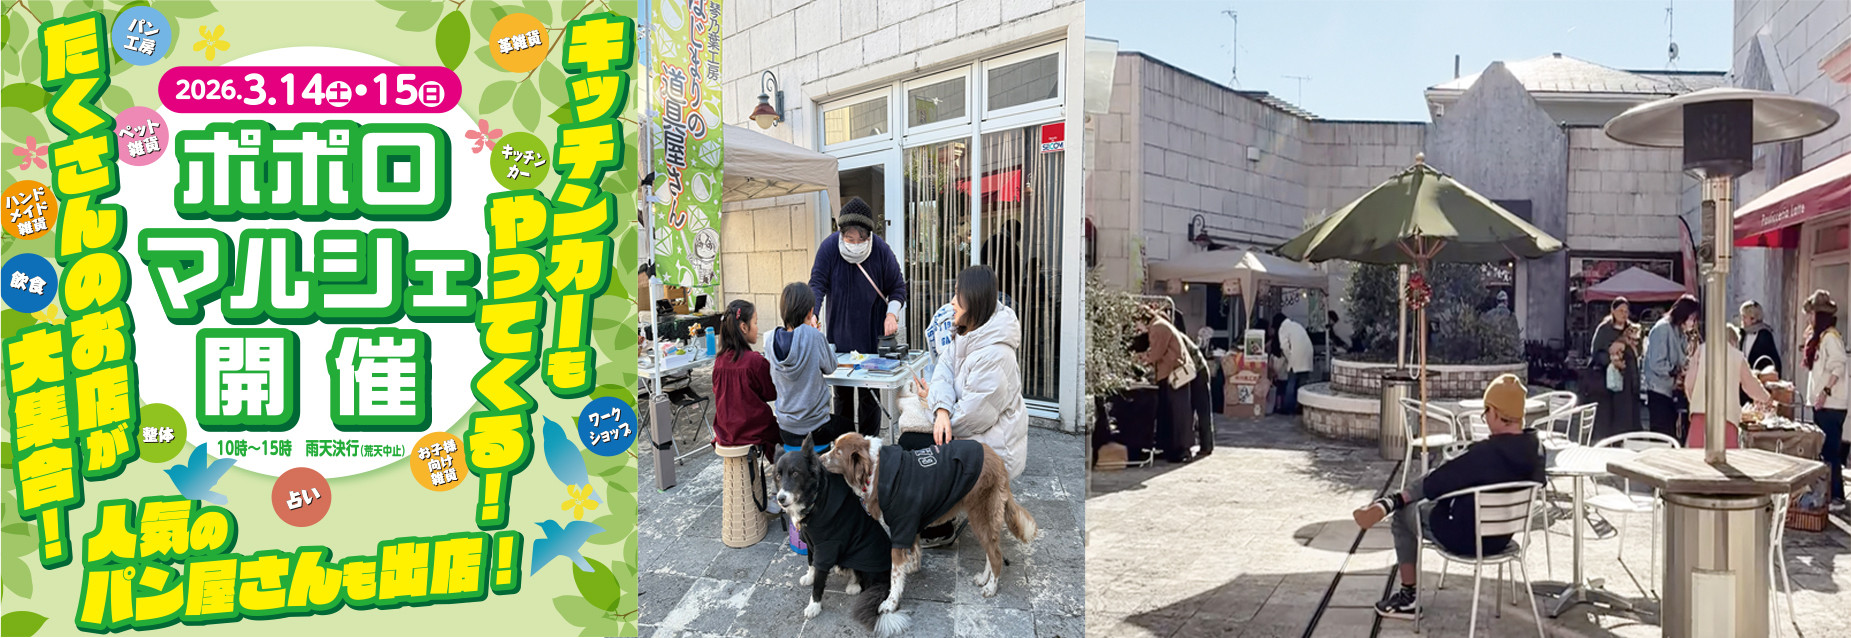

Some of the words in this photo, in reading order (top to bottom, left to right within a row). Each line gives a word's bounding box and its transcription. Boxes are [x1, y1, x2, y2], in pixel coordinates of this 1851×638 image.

[127, 18, 160, 37] パン
[123, 34, 157, 56] 工房
[497, 29, 543, 55] 革雑貨
[118, 118, 160, 139] ペット
[126, 135, 161, 158] 雑貨
[501, 143, 547, 169] キッチン
[661, 61, 688, 230] 道具屋さん
[1041, 141, 1064, 151] SECOM
[181, 127, 438, 208] ポポロ
[506, 164, 532, 181] カー
[5, 186, 46, 210] ハンド
[544, 17, 625, 390] キッチンカーも
[9, 201, 49, 224] メイド
[16, 216, 49, 238] 雑貨
[42, 16, 131, 472] たくさんのお店が
[9, 269, 48, 297] 飲食
[144, 235, 469, 312] マルシェ
[468, 193, 548, 522] やってくる!
[202, 334, 419, 418] 開催
[588, 406, 622, 428] ワーク
[8, 327, 75, 560] 大集合!
[141, 426, 176, 444] 整体
[589, 421, 633, 447] ショップ
[417, 438, 459, 461] お子様
[427, 456, 454, 474] 向け
[430, 467, 459, 487] 雑貨
[285, 486, 322, 511] 占い
[86, 498, 229, 564] 人気の
